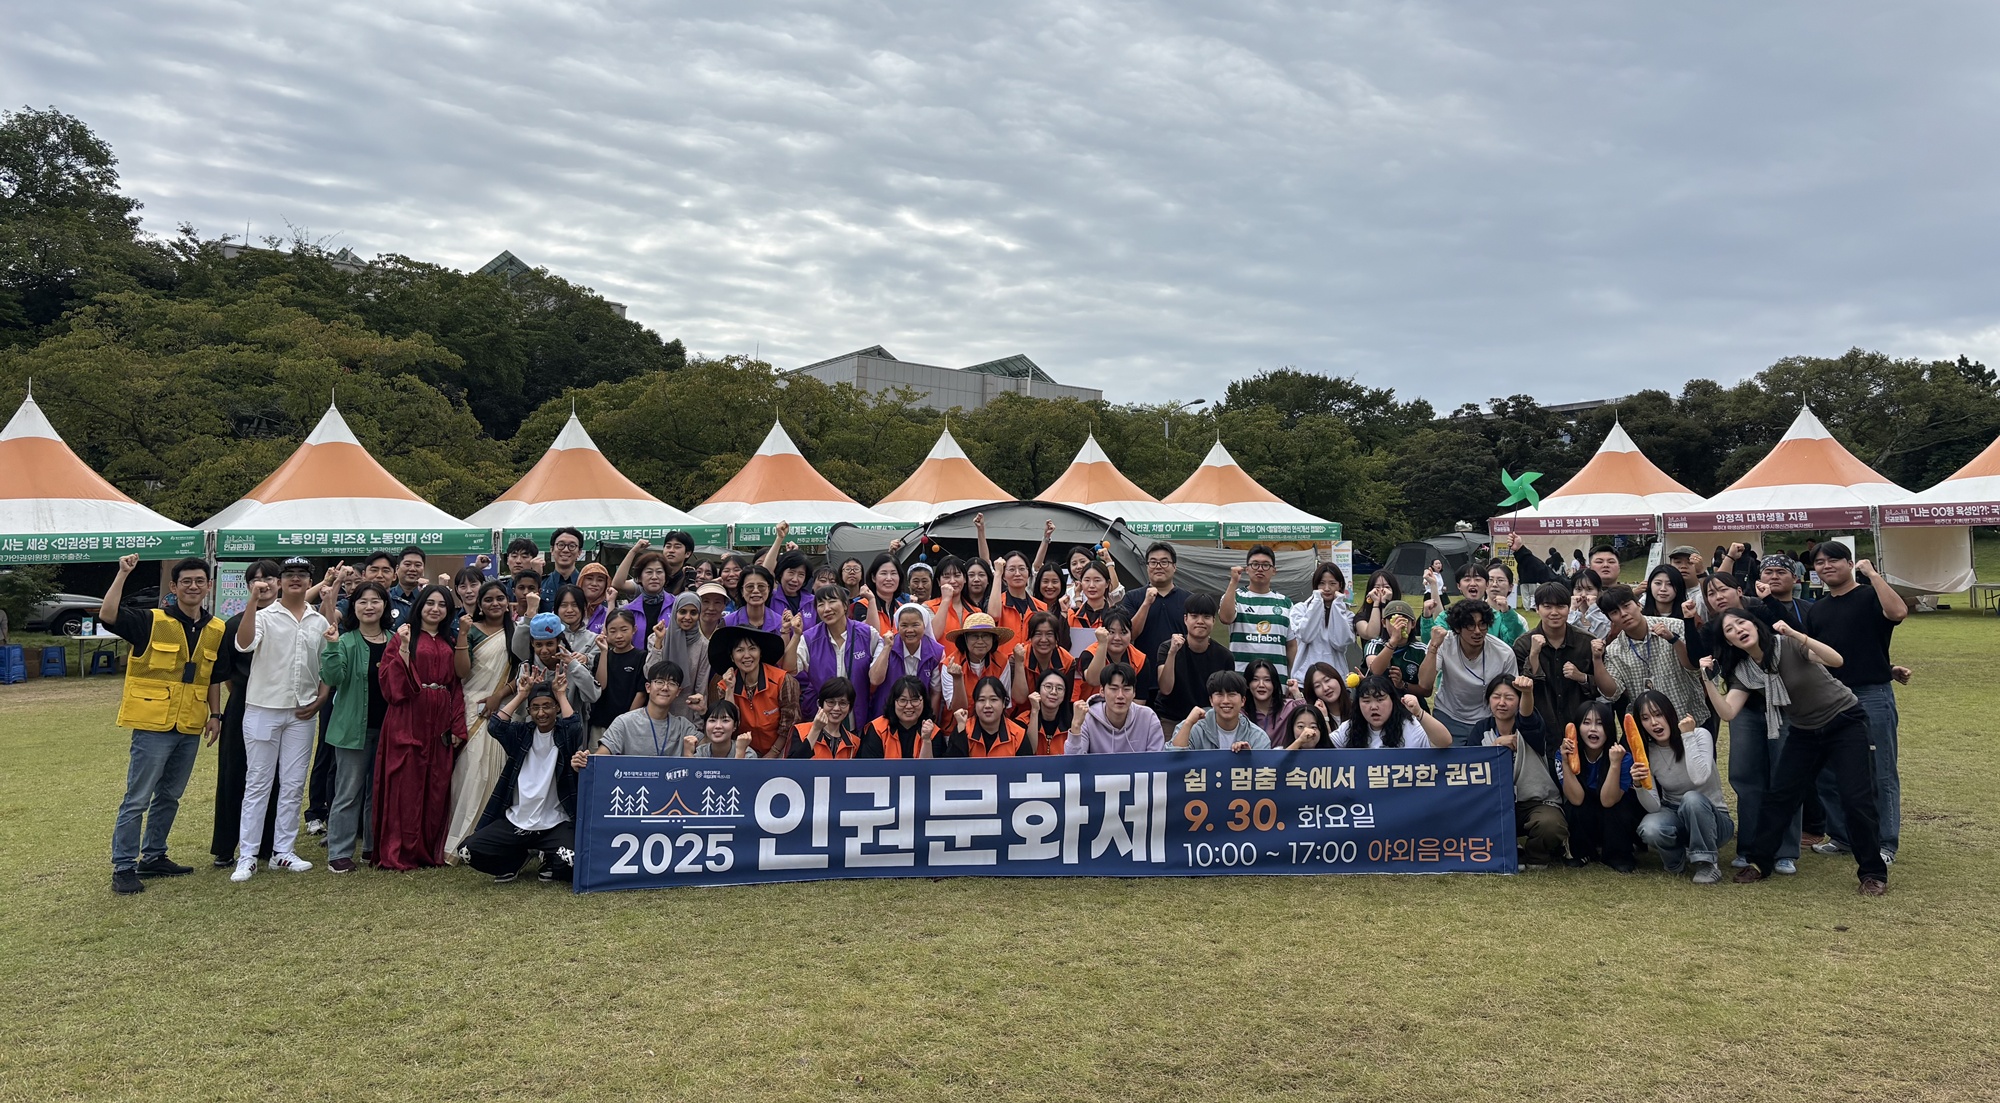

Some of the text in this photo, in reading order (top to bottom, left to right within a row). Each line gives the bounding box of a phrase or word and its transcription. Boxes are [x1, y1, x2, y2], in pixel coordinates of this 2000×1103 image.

[1991, 504, 2000, 515] 국
[1539, 518, 1600, 528] 봄날의 햇살처럼
[1716, 511, 1808, 523] 안정적 대학생활 지원
[764, 526, 771, 536] 내
[1137, 524, 1151, 532] 인권,
[1152, 524, 1164, 532] 차별
[1165, 524, 1181, 532] OUT
[1182, 523, 1194, 532] 사회
[277, 532, 443, 545] 노동인권 퀴즈& 노동연대 선언
[600, 529, 621, 541] 않는
[2, 538, 24, 551] 사는
[27, 537, 48, 551] 세상
[50, 535, 100, 550] <인권상담
[102, 536, 113, 549] 및
[115, 535, 163, 548] 진정접수>
[51, 552, 91, 561] 제주출장소
[1245, 633, 1281, 643] dafabet
[665, 768, 689, 781] WITH
[1184, 762, 1492, 793] 쉼 : 멈춤 속에서 발견한 권리
[754, 770, 1168, 872] 인권문화제
[1183, 797, 1376, 833] 9. 30. 화요일
[609, 833, 736, 875] 2025
[1183, 842, 1257, 868] 10:00
[1288, 840, 1358, 865] 17:00
[1368, 837, 1494, 863] 야외음악당
